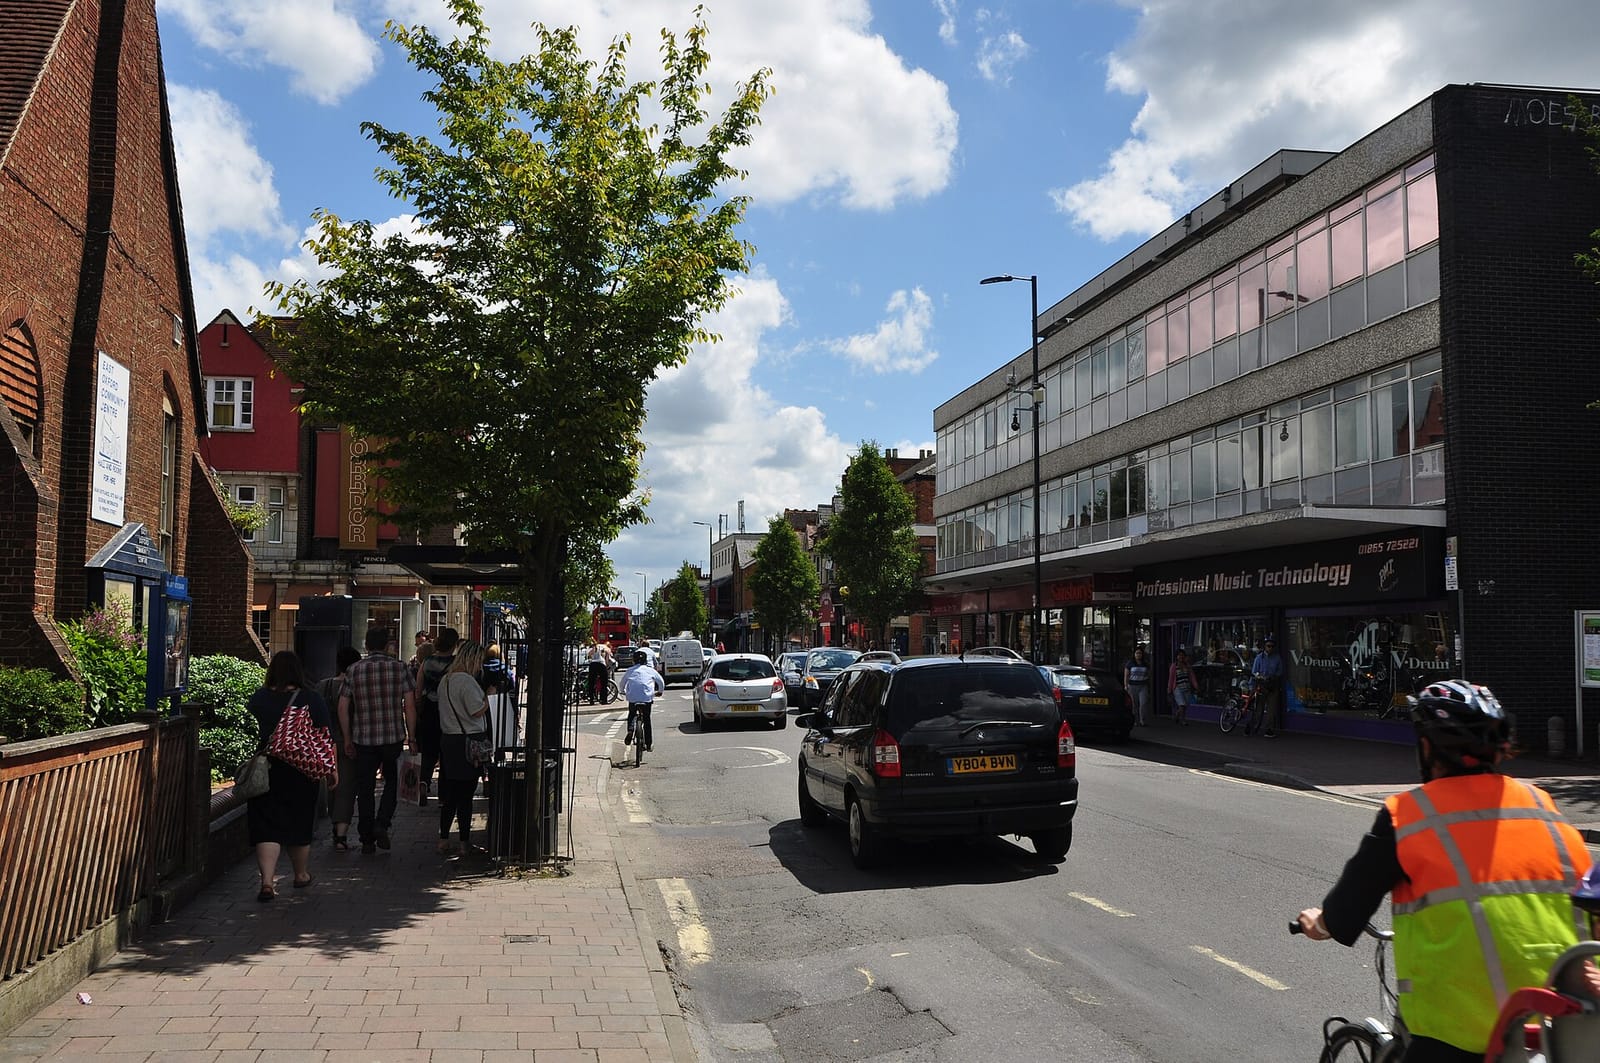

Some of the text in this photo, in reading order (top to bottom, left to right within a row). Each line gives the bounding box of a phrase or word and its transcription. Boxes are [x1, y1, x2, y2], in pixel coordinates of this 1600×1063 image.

[102, 361, 114, 373] EAST
[102, 374, 119, 391] OXFORD
[101, 388, 126, 408] COMMUNITY
[349, 432, 369, 543] ORRIDOR
[1358, 538, 1419, 555] 01865 725221
[1136, 562, 1351, 598] Professional Music Technology
[954, 755, 1015, 771] YB04 BVN
